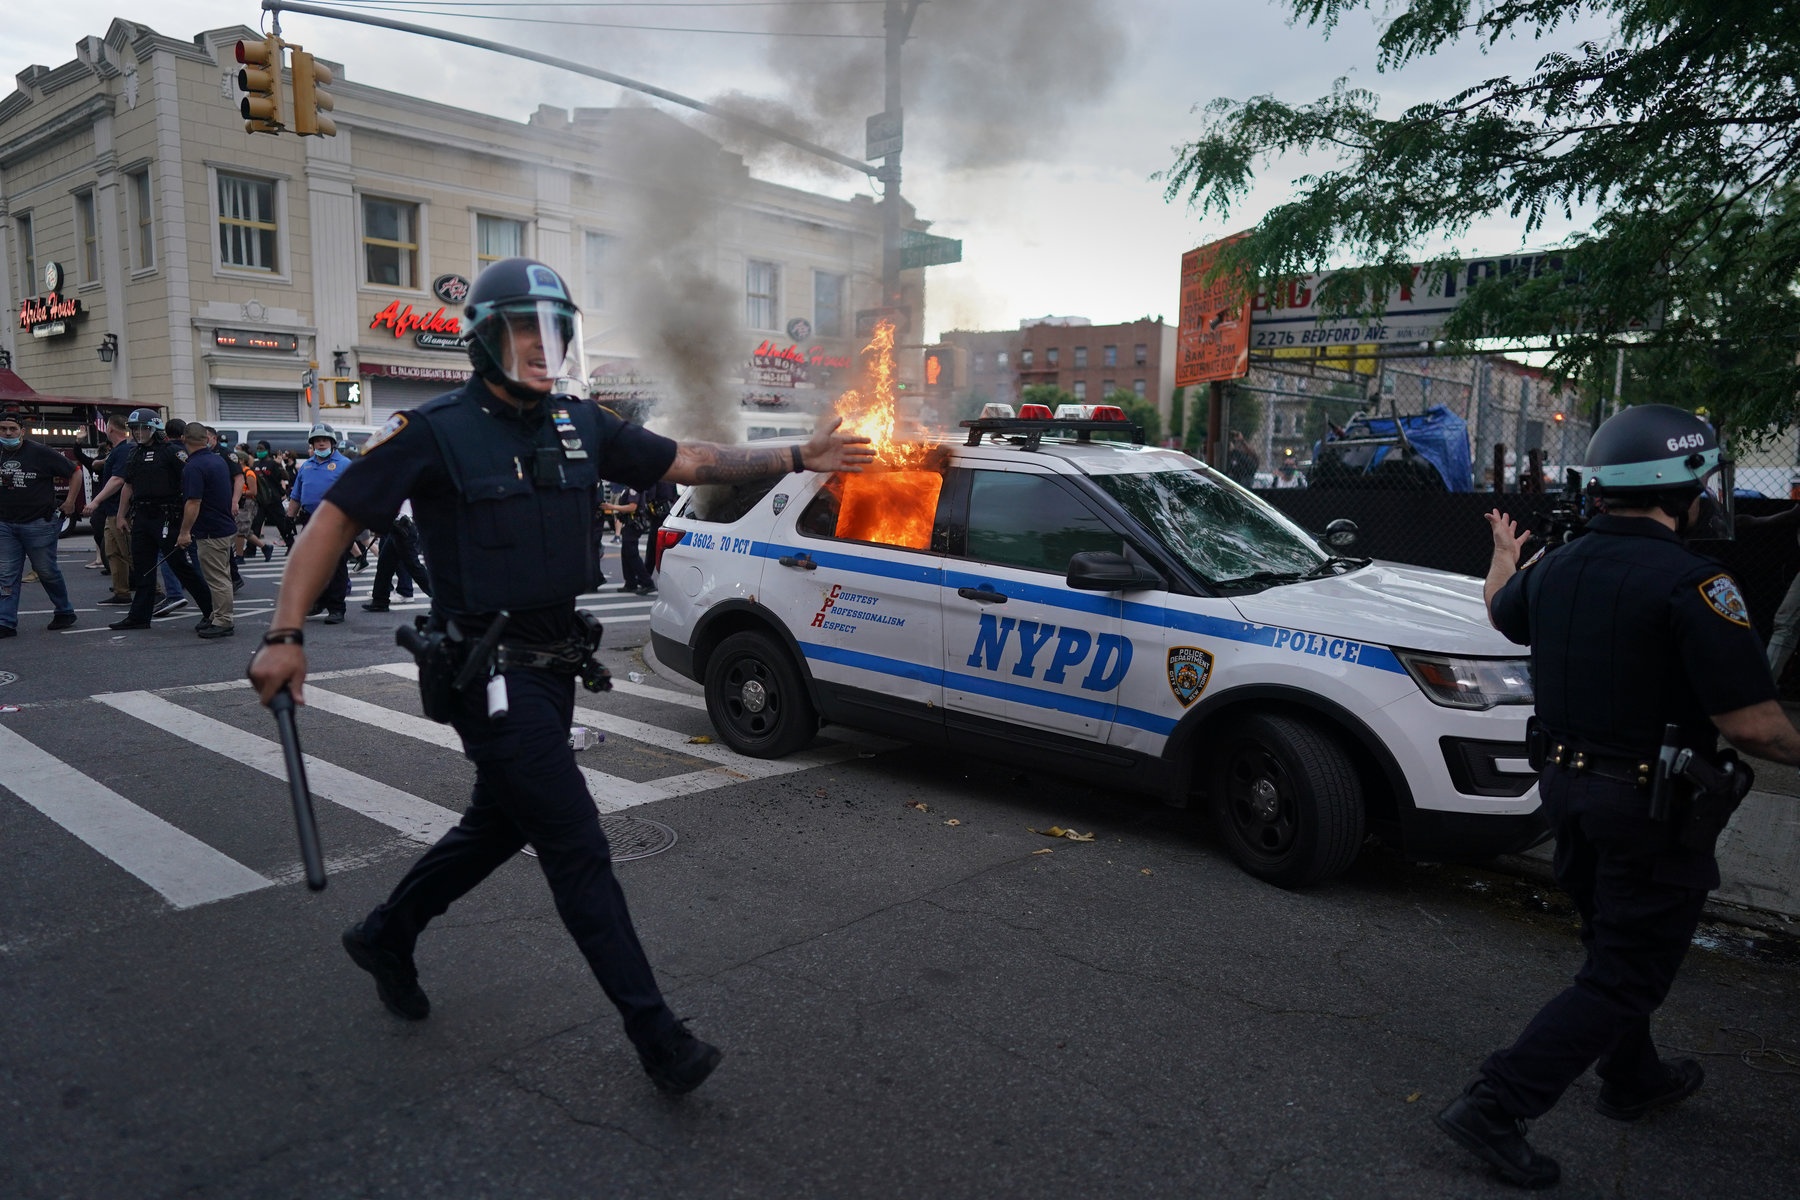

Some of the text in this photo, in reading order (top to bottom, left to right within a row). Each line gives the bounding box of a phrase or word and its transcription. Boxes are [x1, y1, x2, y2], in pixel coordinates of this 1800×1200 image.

[20, 297, 48, 333] Afrika
[48, 292, 77, 319] House
[370, 300, 461, 338] Afrika
[421, 332, 459, 347] Banquet
[1257, 331, 1295, 346] 2276
[1301, 327, 1361, 343] BEDFORD
[1184, 349, 1206, 363] 8AM
[1215, 343, 1236, 358] 3PM
[390, 366, 398, 375] EL
[398, 366, 420, 377] PALACIO
[420, 368, 445, 379] ELEGANTE
[445, 369, 453, 379] DE
[453, 370, 462, 380] LOS
[1667, 433, 1705, 452] 6450
[692, 532, 712, 550] 3602
[720, 536, 731, 551] 70
[732, 538, 750, 555] PCT
[830, 584, 879, 606] COURTESY
[810, 613, 857, 634] RESPECT
[820, 599, 906, 627] PROFESSIONALISM
[967, 614, 1134, 693] NYPD
[1180, 649, 1204, 659] POLICE
[1274, 626, 1360, 662] POLICE
[1169, 655, 1210, 670] DEPARTMENT
[1188, 673, 1209, 701] NEW YORK
